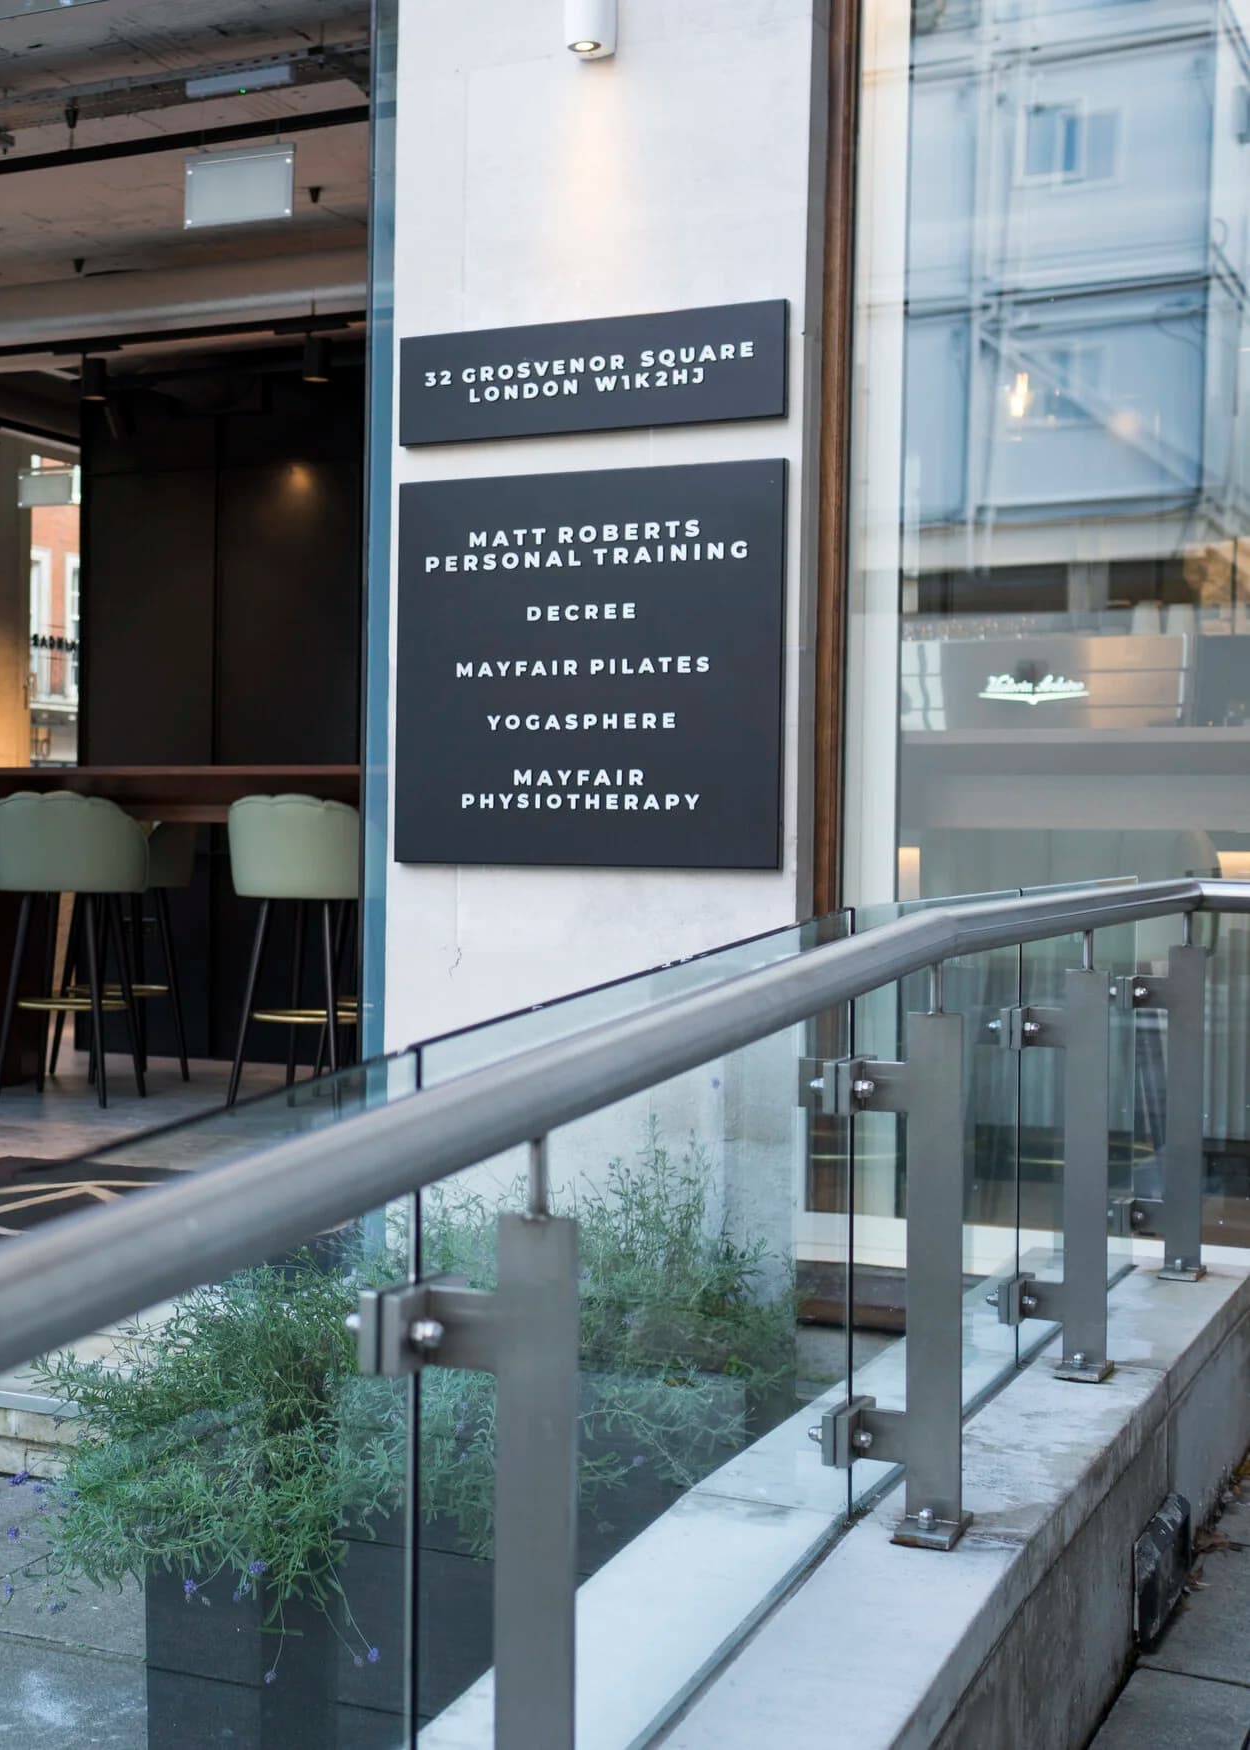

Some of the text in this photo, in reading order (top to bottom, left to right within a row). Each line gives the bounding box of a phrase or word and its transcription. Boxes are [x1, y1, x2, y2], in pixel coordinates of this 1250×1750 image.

[424, 341, 754, 387] 32 GROSVENOR SQUARE
[469, 367, 704, 403] LONDON W1K2HJ
[469, 519, 700, 548] MATT ROBERTS
[425, 540, 748, 573] PERSONAL TRAINING
[526, 602, 636, 622] DECREE
[456, 655, 710, 678] MAYFAIR PILATES
[487, 711, 676, 731] YOGASPHERE
[513, 768, 644, 787] MAYFAIR
[461, 793, 700, 811] PHYSIOTHERAPY
